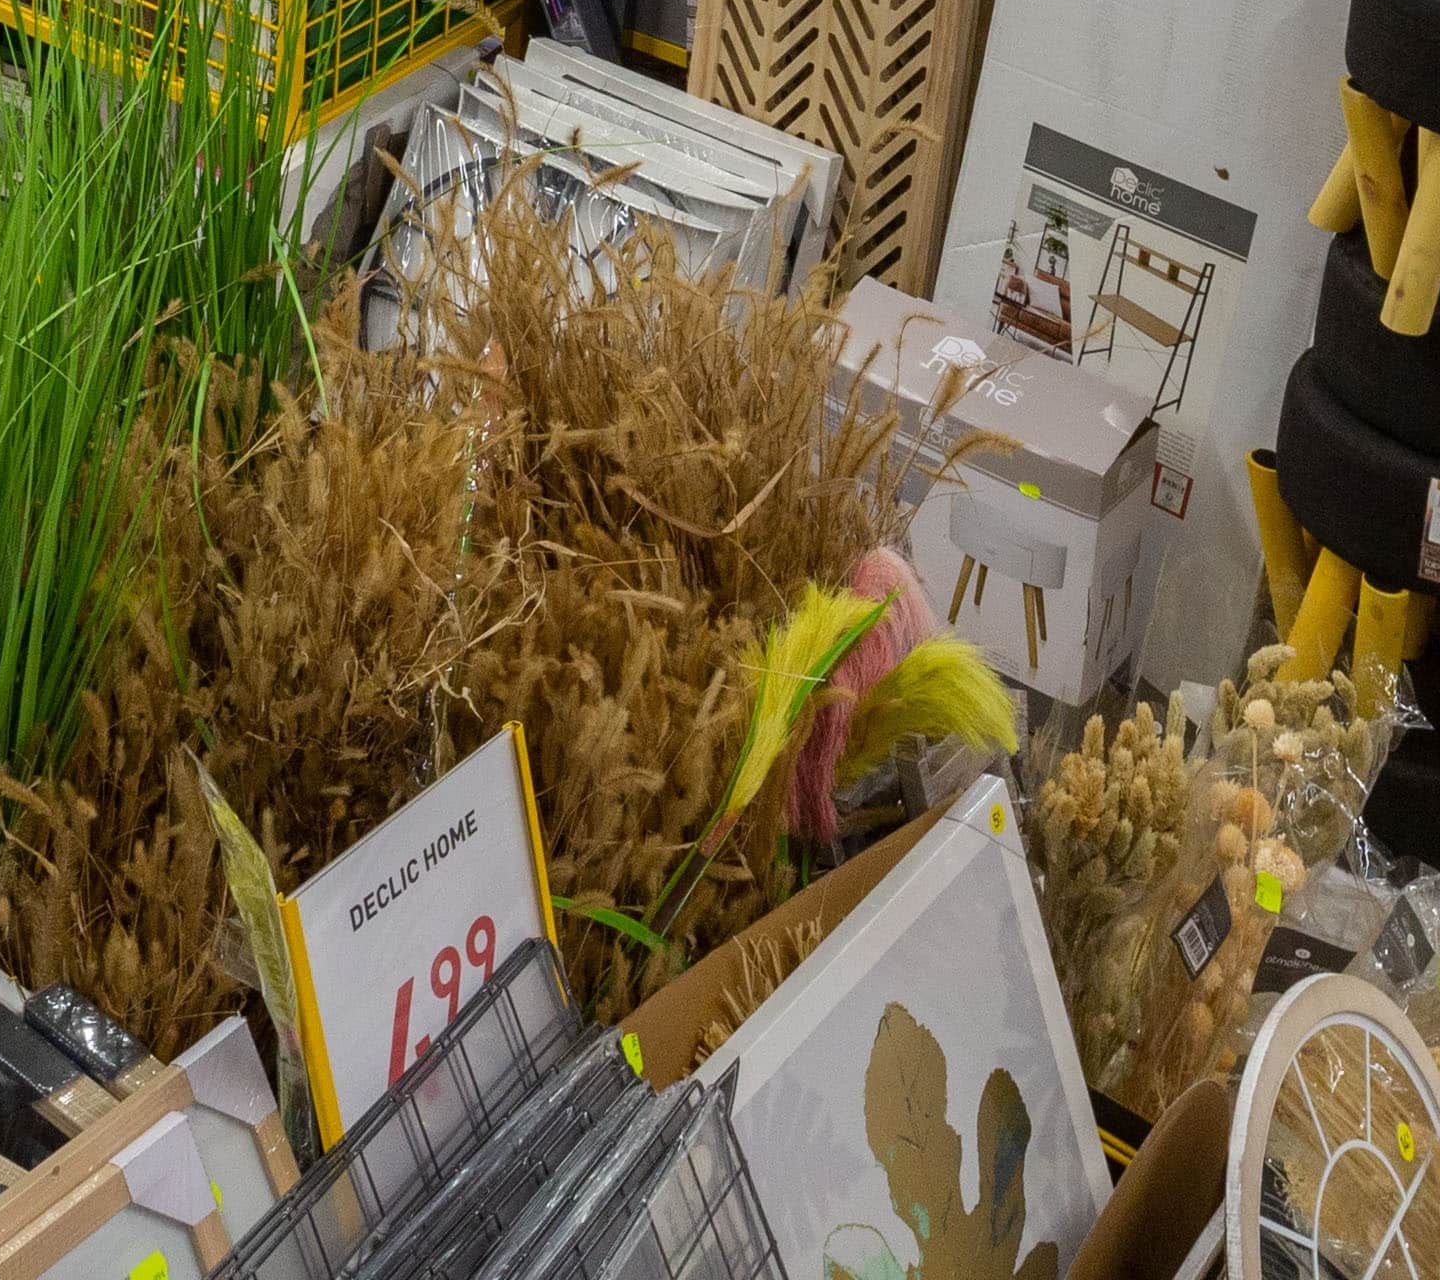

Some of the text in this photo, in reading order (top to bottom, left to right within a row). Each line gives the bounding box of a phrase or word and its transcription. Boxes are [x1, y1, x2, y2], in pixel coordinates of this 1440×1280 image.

[1110, 184, 1162, 218] home
[348, 808, 479, 933] DECLIC HOME
